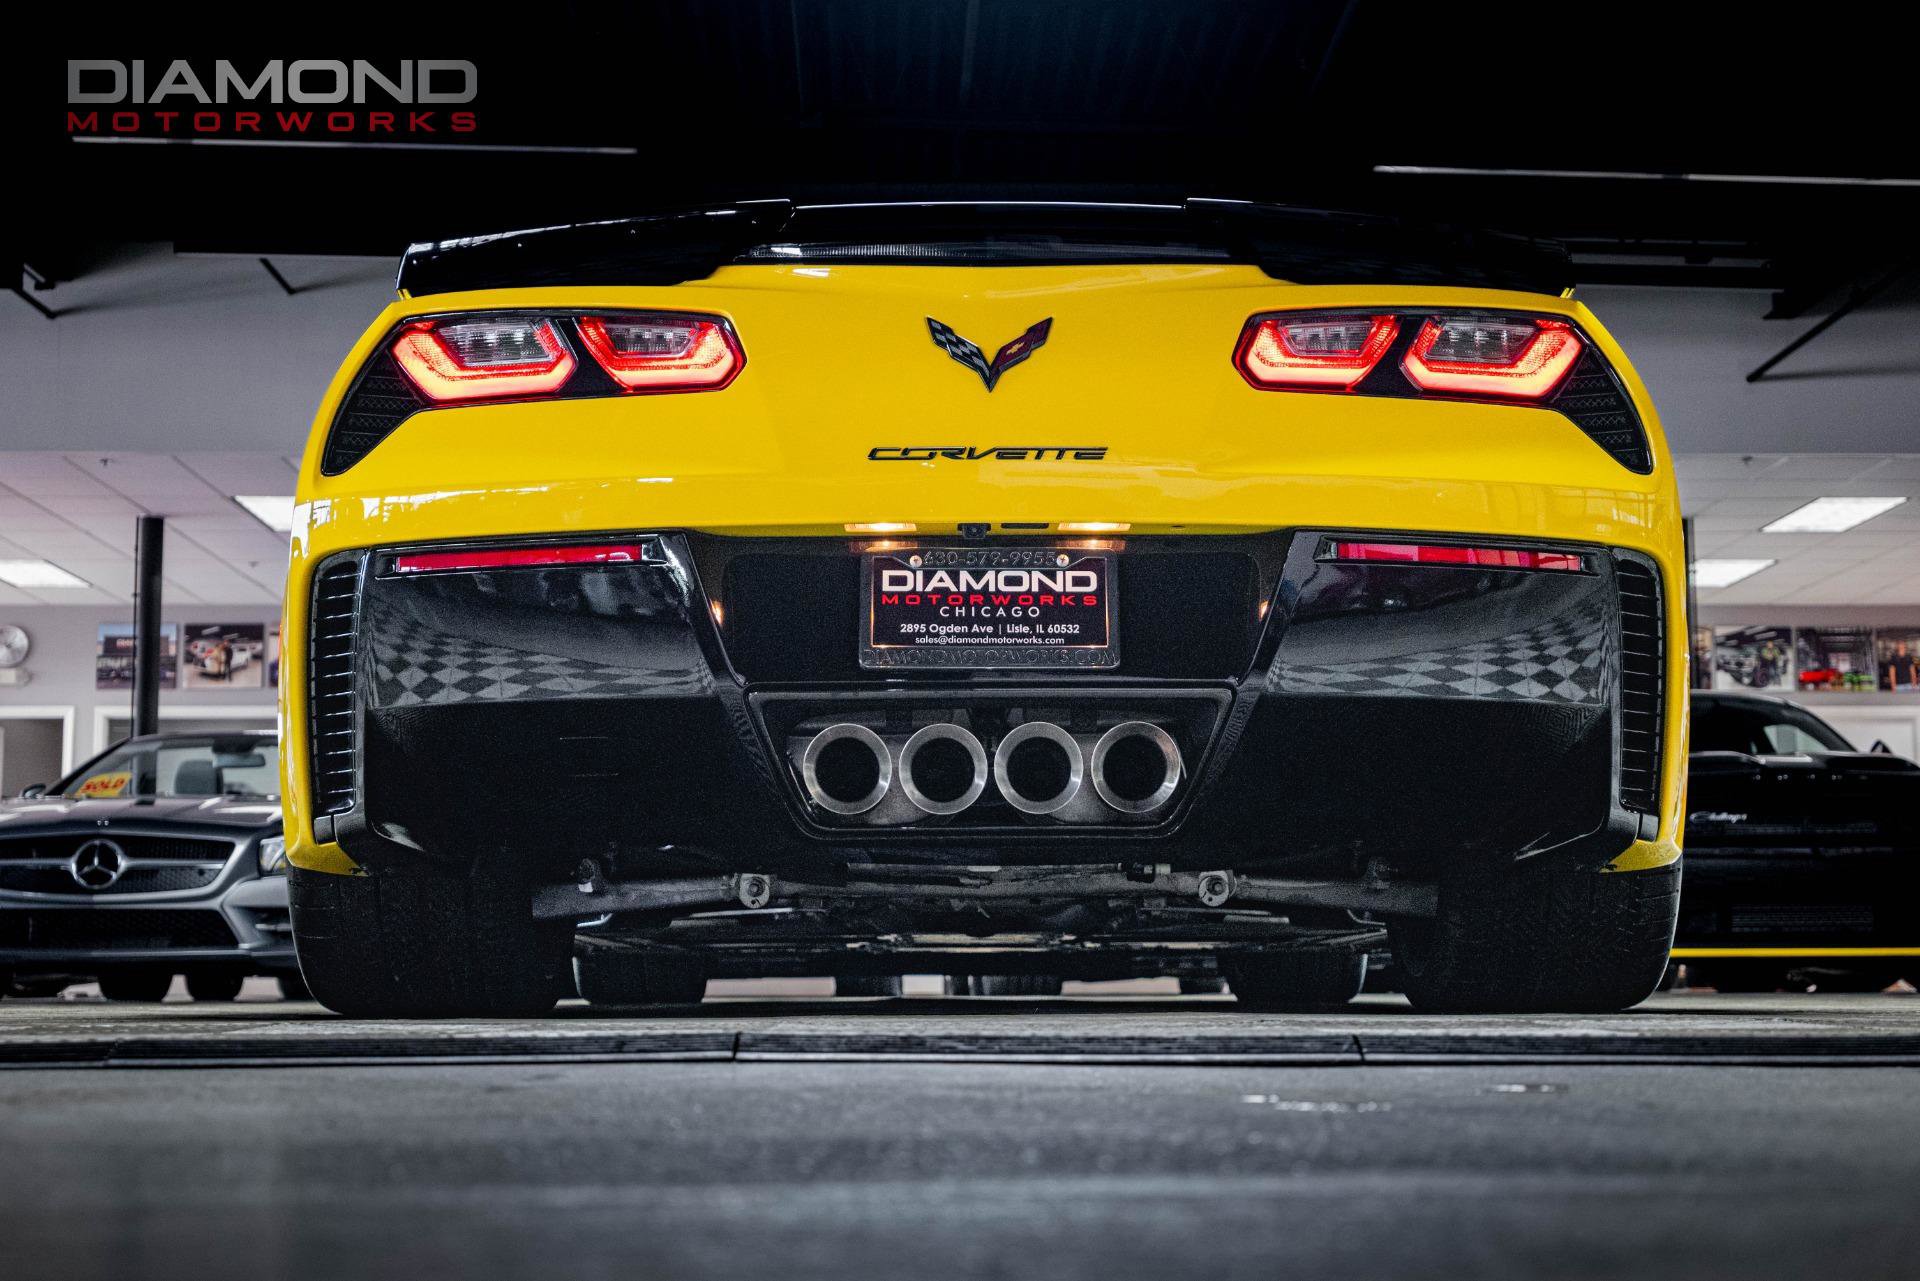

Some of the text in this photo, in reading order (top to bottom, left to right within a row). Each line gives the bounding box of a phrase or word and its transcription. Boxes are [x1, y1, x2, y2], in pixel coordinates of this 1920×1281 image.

[867, 446, 1108, 461] CORVETTE
[881, 569, 1098, 592] DIAMOND
[881, 594, 1098, 606] MOTORWORKS
[939, 606, 1041, 618] CHICAGO
[900, 623, 927, 634] 2895
[928, 623, 968, 636] Ogden
[971, 623, 994, 634] Ave
[1006, 623, 1033, 636] Lisle,
[1035, 623, 1045, 634] IL
[1047, 623, 1080, 635] 60532
[915, 635, 1065, 646] sales@diamondmotorworks.com
